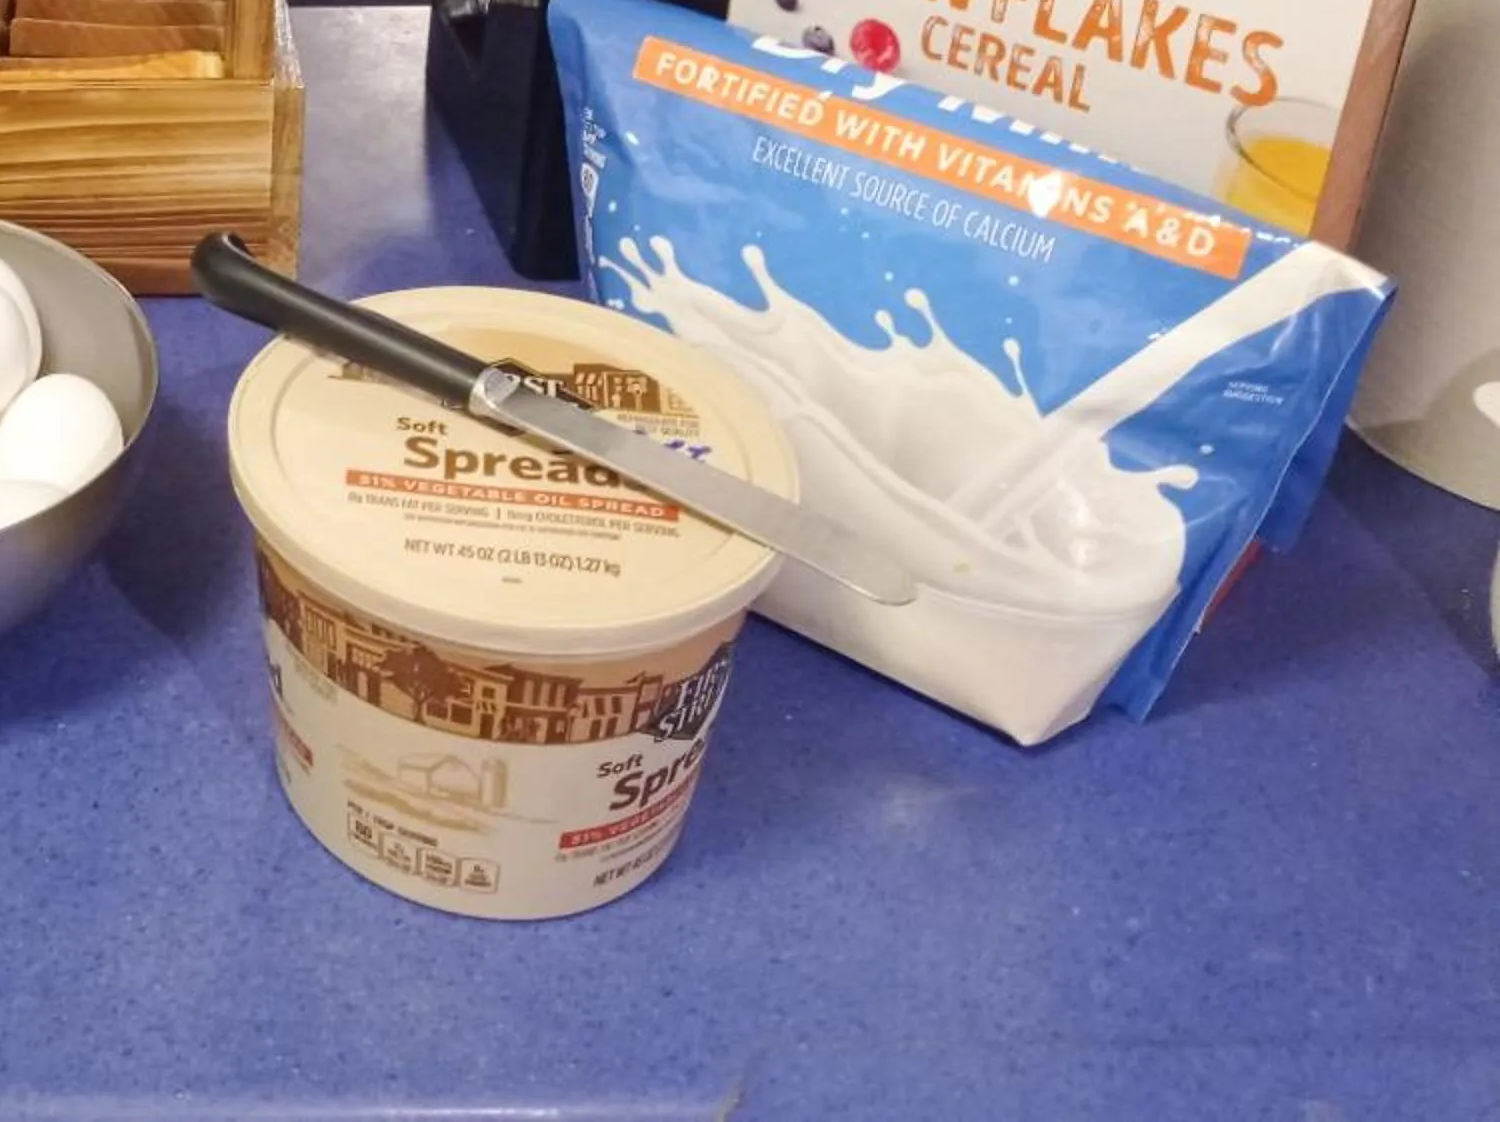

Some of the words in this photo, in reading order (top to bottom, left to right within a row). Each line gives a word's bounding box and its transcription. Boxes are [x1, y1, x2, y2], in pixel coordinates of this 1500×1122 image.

[919, 14, 1092, 114] CEREAL
[656, 51, 825, 127] FORTIFIED
[835, 109, 925, 162] WITH
[937, 143, 1115, 224] VITANS
[752, 135, 851, 191] EXCELLENT
[850, 170, 936, 221] SOURCE
[931, 199, 962, 229] OF
[962, 209, 1057, 264] CALCIUM
[396, 416, 448, 436] Soft
[404, 479, 529, 502] VEGETABLE
[533, 492, 573, 506] OIL
[578, 497, 667, 517] SPREAD
[404, 537, 431, 553] NET
[433, 541, 455, 557] WT
[457, 545, 475, 559] 45
[476, 546, 495, 562] OZ
[497, 548, 514, 565] (2
[514, 550, 532, 566] LB
[533, 552, 548, 567] 13
[549, 554, 574, 572] OZ)
[575, 556, 602, 574] 1.27
[597, 752, 644, 779] Soft
